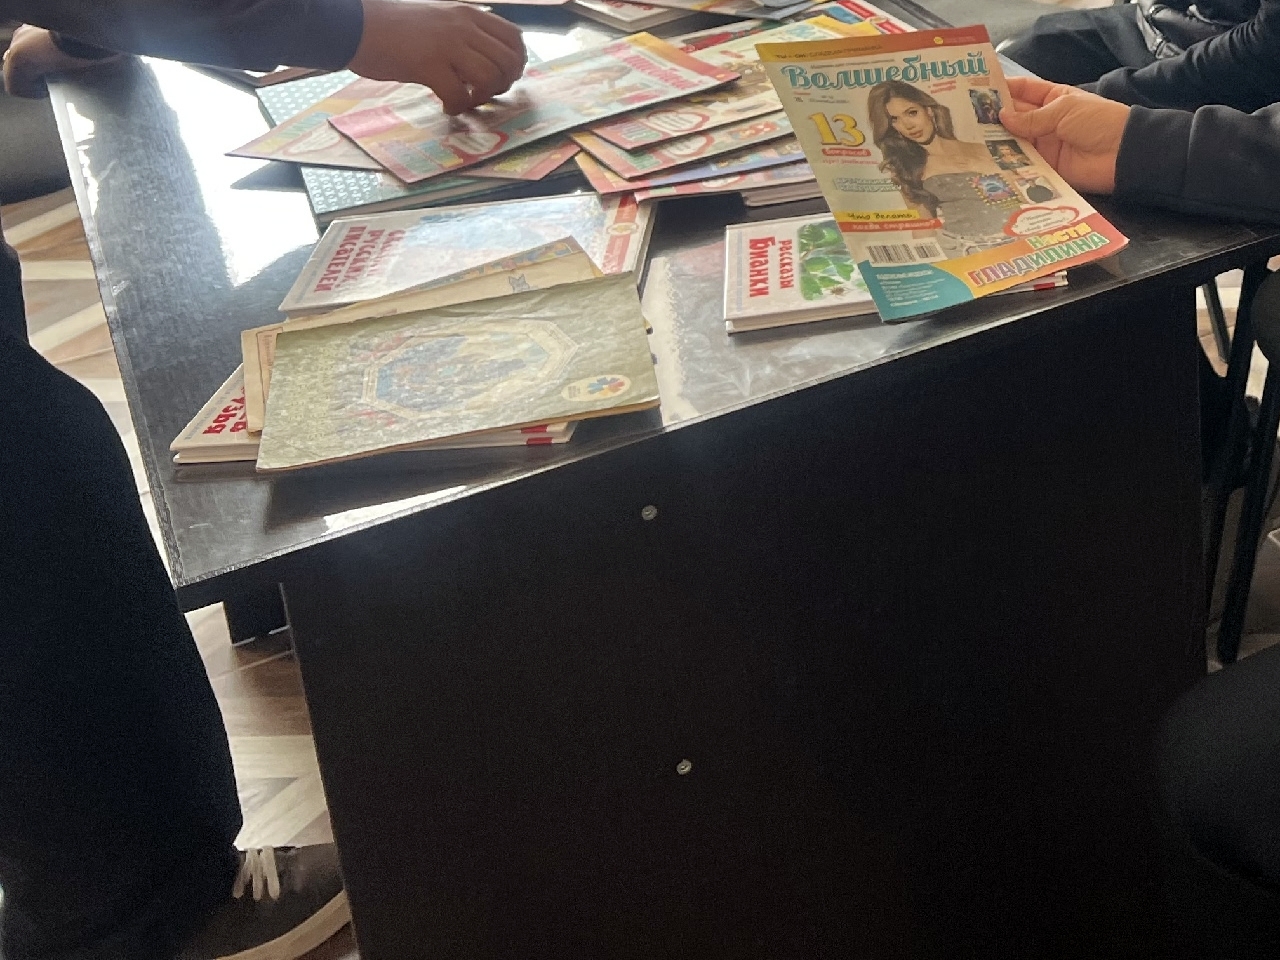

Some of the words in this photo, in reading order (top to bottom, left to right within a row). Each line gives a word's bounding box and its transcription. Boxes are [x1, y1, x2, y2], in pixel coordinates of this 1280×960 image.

[780, 50, 991, 90] Волшебный
[808, 111, 866, 147] 13
[749, 236, 776, 298] Бианки
[778, 238, 795, 289] рассказы
[966, 231, 1111, 287] ГЛАДИЛИНА
